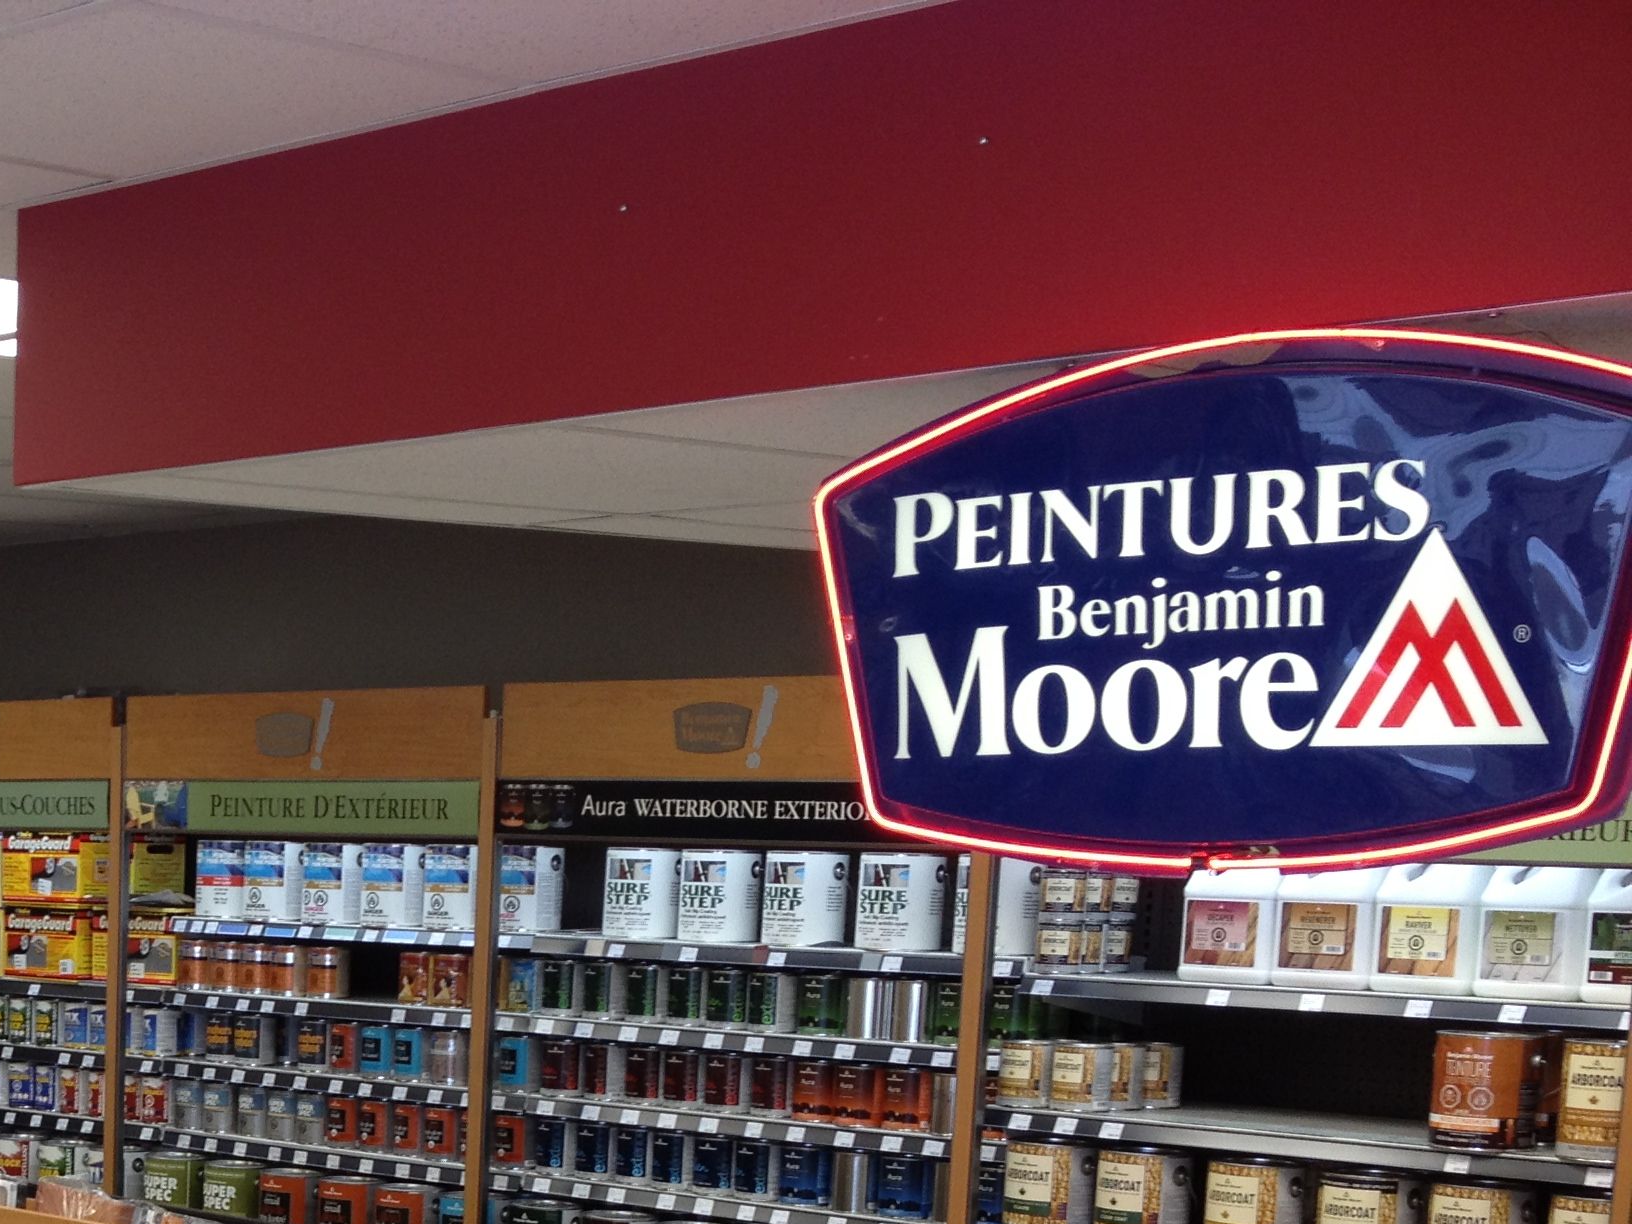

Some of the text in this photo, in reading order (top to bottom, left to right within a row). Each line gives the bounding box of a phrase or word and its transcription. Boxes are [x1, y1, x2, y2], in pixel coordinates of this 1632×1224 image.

[892, 458, 1431, 578] PEINTURES
[1037, 570, 1326, 650] Benjamin
[894, 625, 1320, 760] Moore
[209, 793, 448, 820] PEINTURE D'EXTÉRIEUR
[582, 795, 625, 817] Aura
[634, 798, 767, 819] WATERBORNE
[607, 881, 649, 894] SURE
[682, 885, 725, 897] SURE
[607, 893, 649, 906] STEP
[682, 896, 724, 908] STEP
[860, 888, 908, 902] SURE
[860, 902, 906, 914] STEP
[145, 1187, 172, 1201] SPEC
